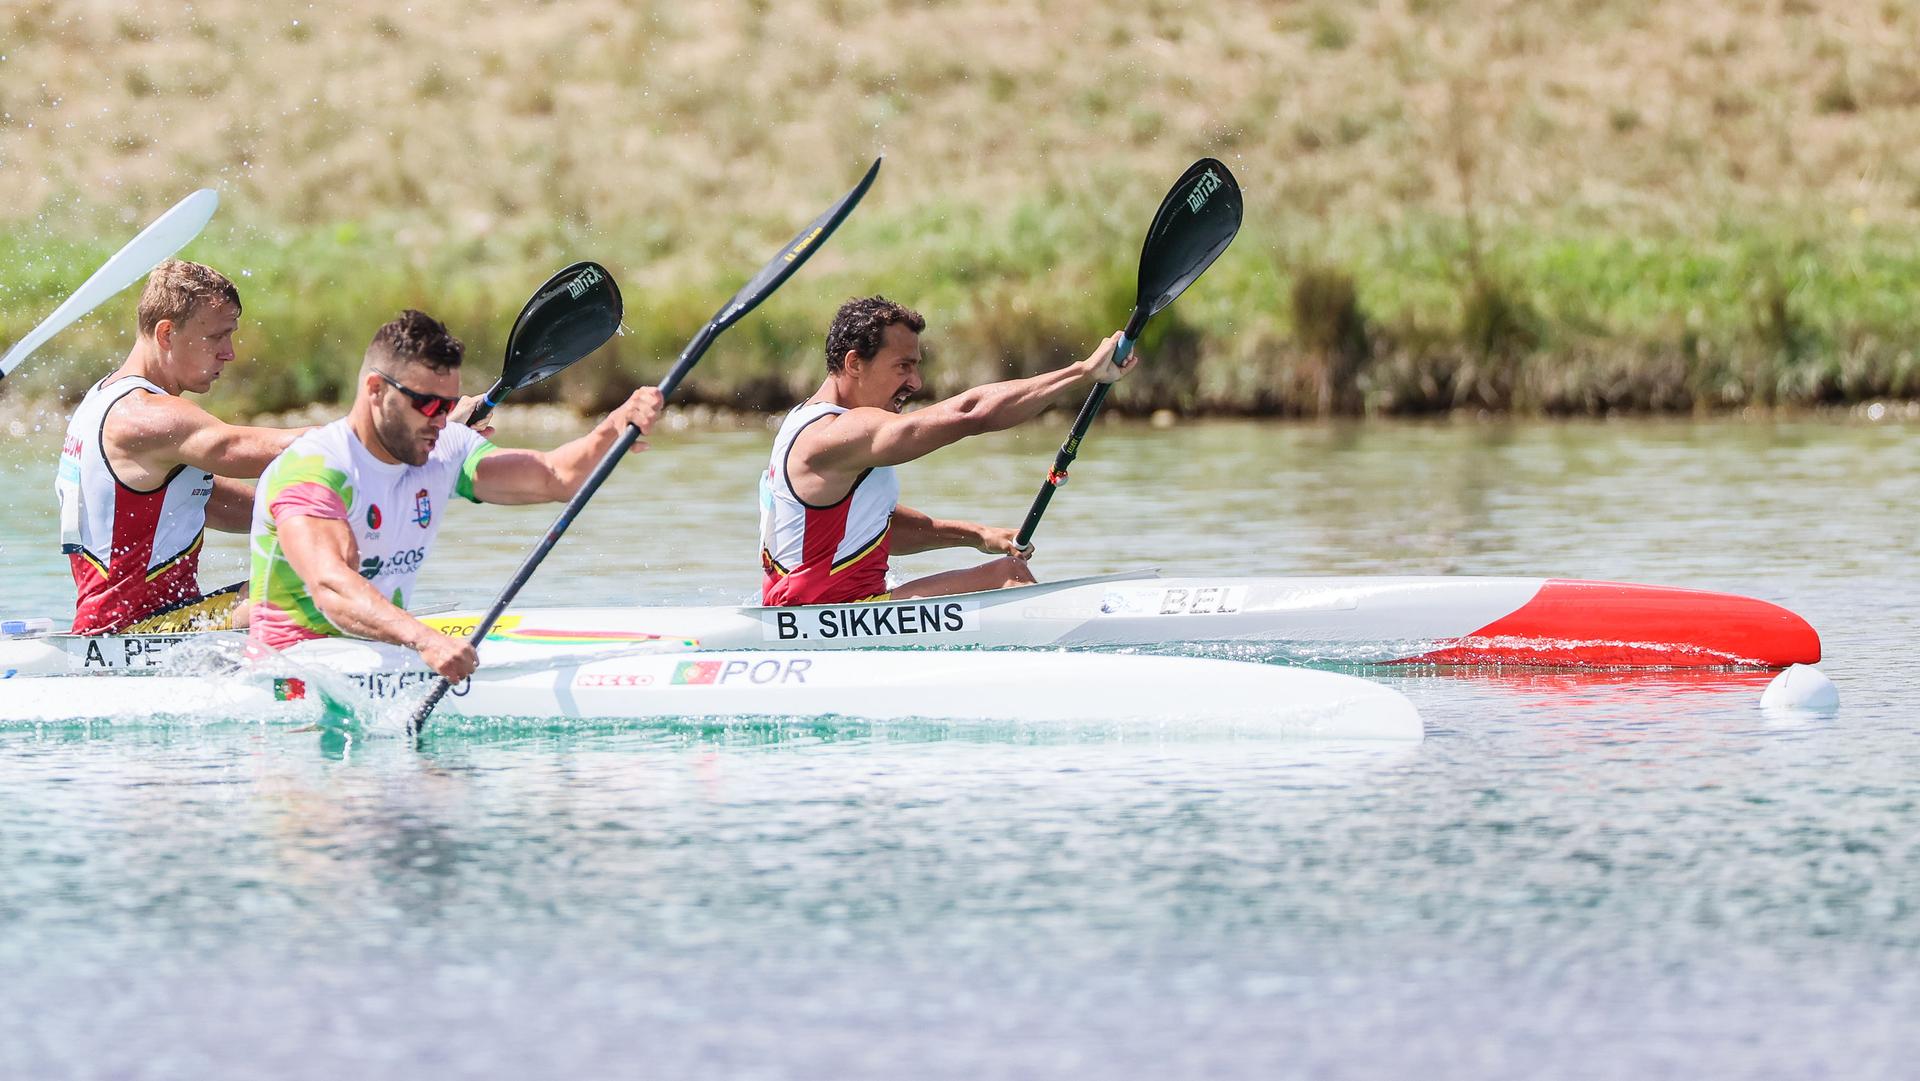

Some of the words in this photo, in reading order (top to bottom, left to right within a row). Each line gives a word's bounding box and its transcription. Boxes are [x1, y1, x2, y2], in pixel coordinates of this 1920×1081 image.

[1159, 588, 1237, 614] BEL
[440, 625, 502, 637] SPOT
[777, 612, 808, 640] B.
[819, 603, 964, 638] SIKKENS
[84, 639, 113, 667] A.
[719, 659, 812, 685] POR
